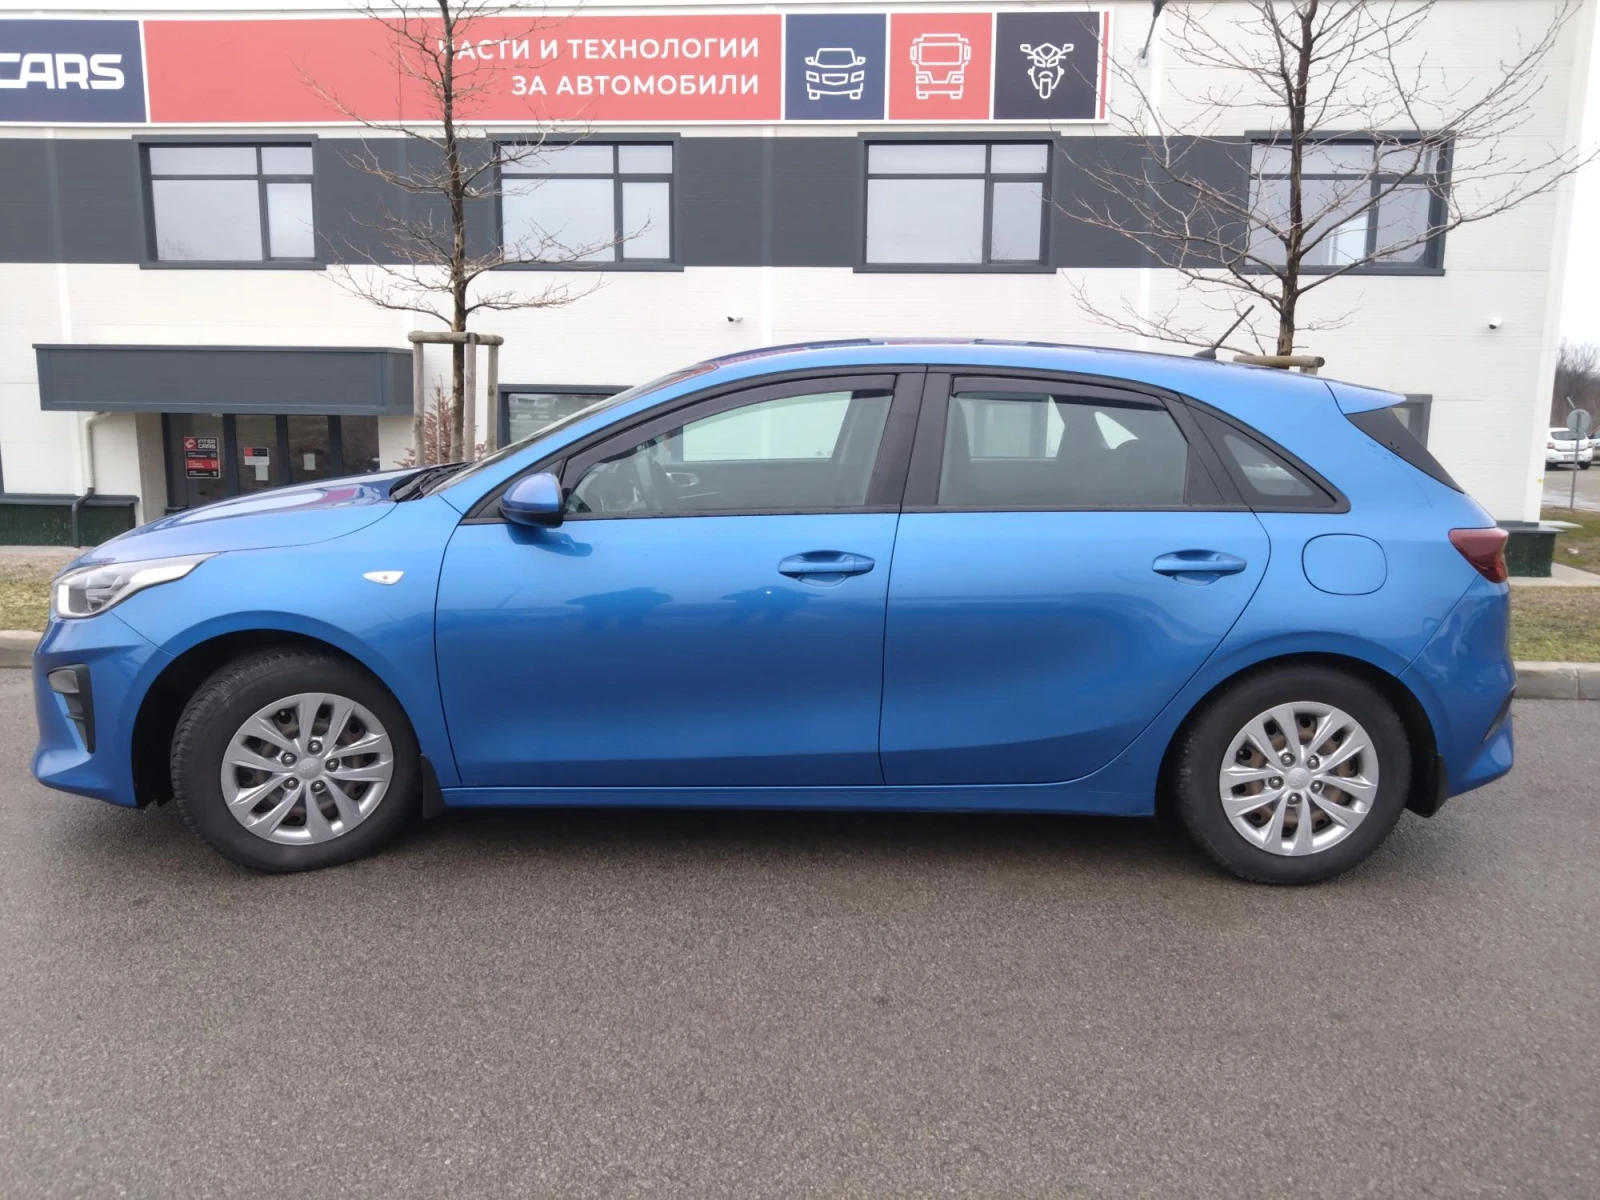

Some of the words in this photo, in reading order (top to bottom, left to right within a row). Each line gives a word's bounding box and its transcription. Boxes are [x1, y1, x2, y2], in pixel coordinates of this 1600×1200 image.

[540, 38, 558, 59] И
[567, 37, 759, 59] ТЕХНОЛОГИИ
[0, 53, 125, 90] CARS
[511, 75, 547, 96] ЗА
[556, 74, 759, 96] АВТОМОБИЛИ
